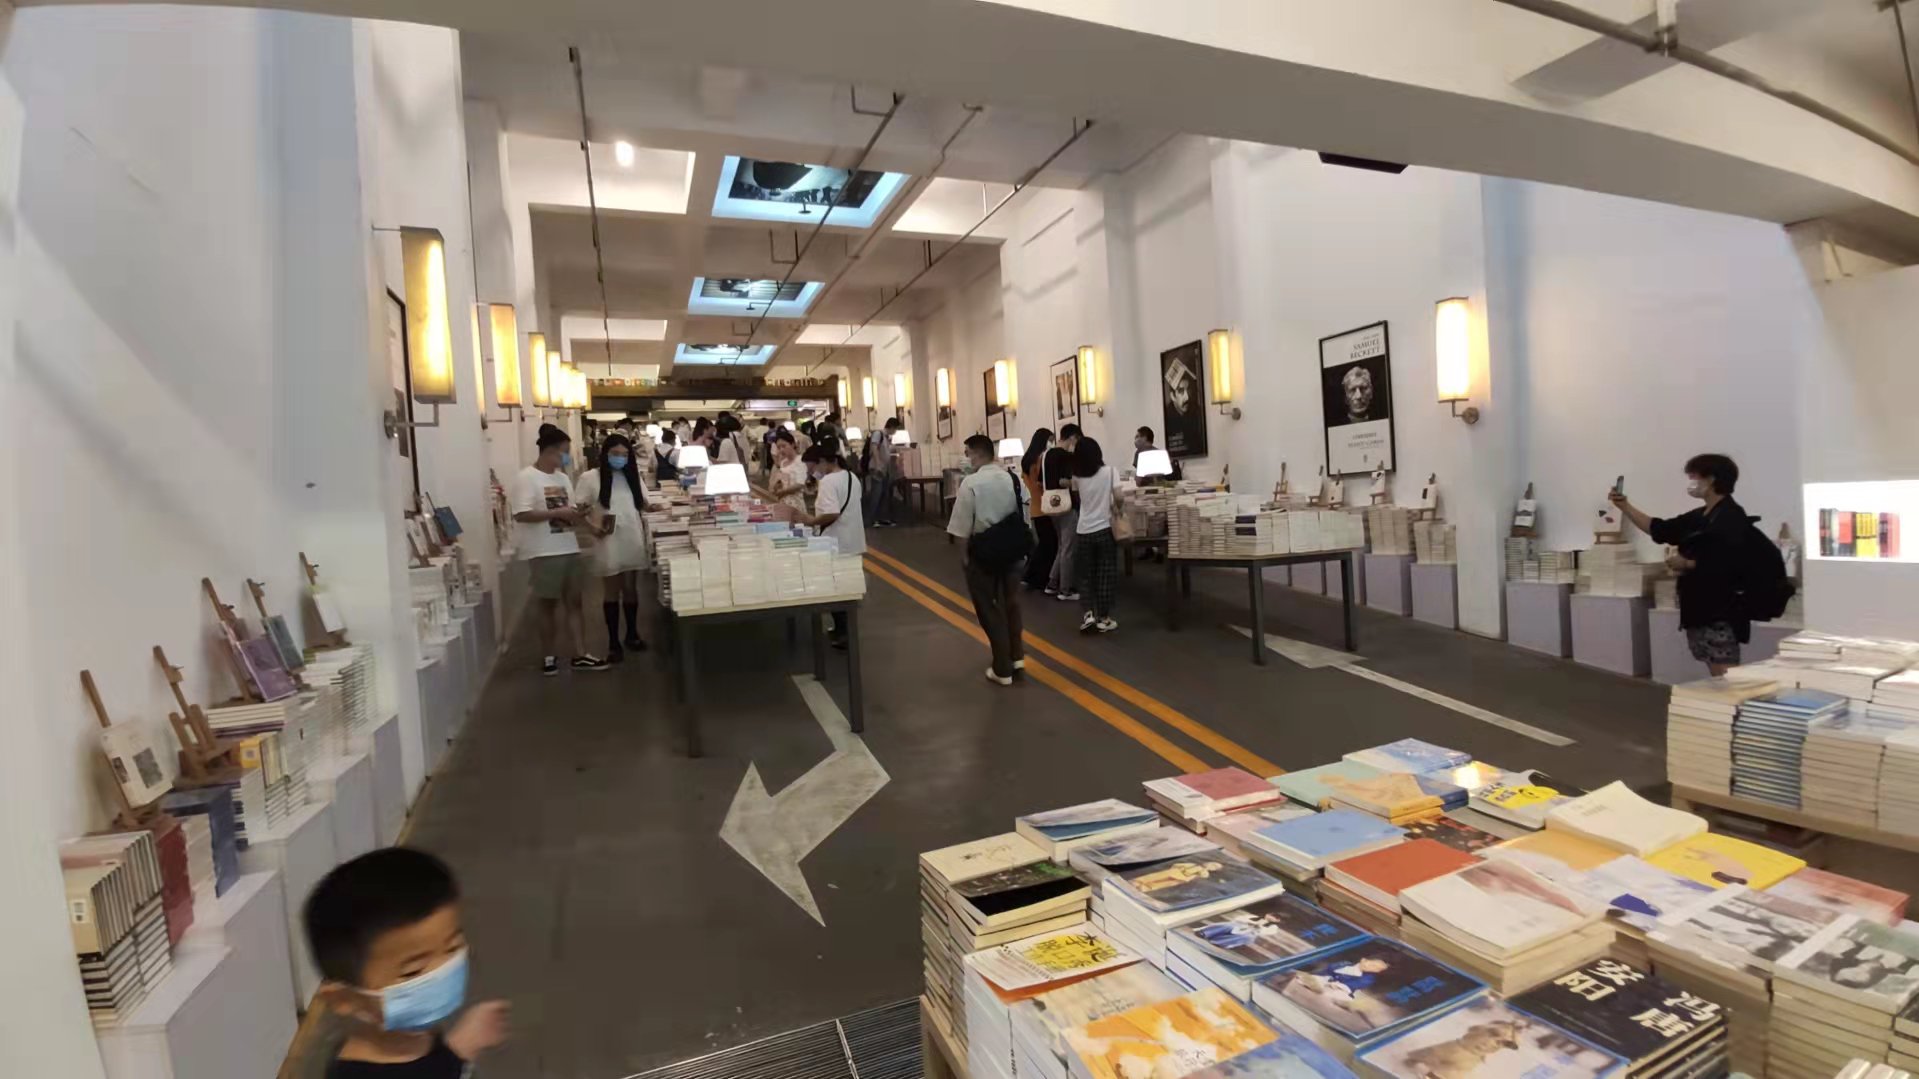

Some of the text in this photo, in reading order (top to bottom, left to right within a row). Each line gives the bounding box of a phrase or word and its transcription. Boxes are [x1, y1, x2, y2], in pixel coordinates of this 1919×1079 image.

[1350, 346, 1380, 359] BECKETT
[1353, 338, 1379, 351] SAMUEL
[1552, 959, 1645, 1001] 安阳
[1629, 990, 1721, 1037] 冯唐
